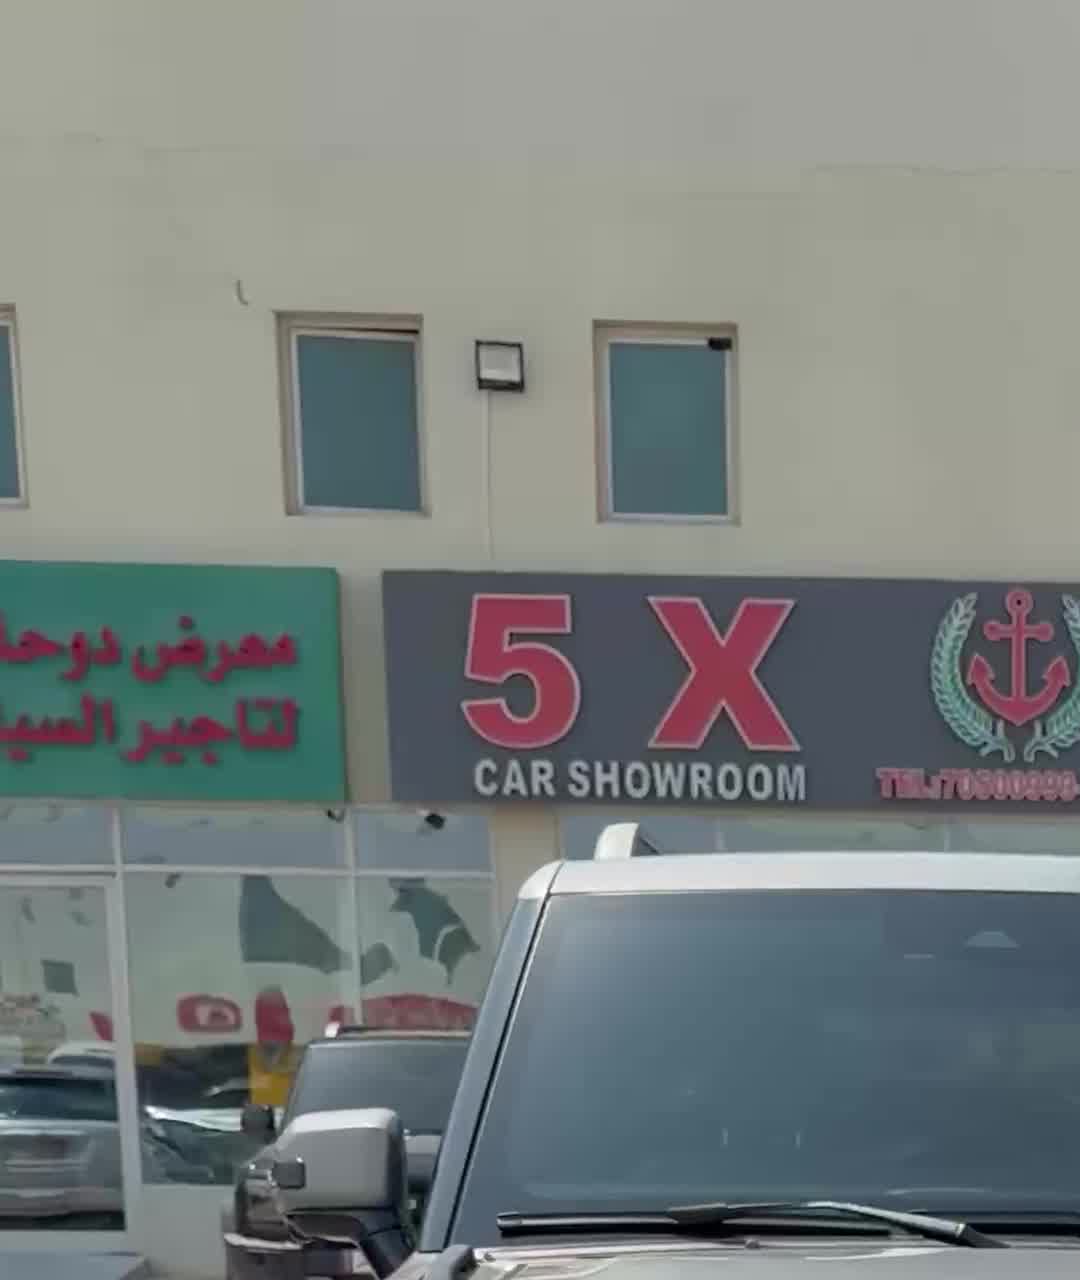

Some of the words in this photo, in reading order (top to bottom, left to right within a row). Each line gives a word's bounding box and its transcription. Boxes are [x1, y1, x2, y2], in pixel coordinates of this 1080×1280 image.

[131, 615, 298, 683] معرض
[461, 592, 581, 749] 5
[646, 596, 801, 751] X
[474, 759, 556, 796] CAR
[567, 760, 807, 800] SHOWROOM
